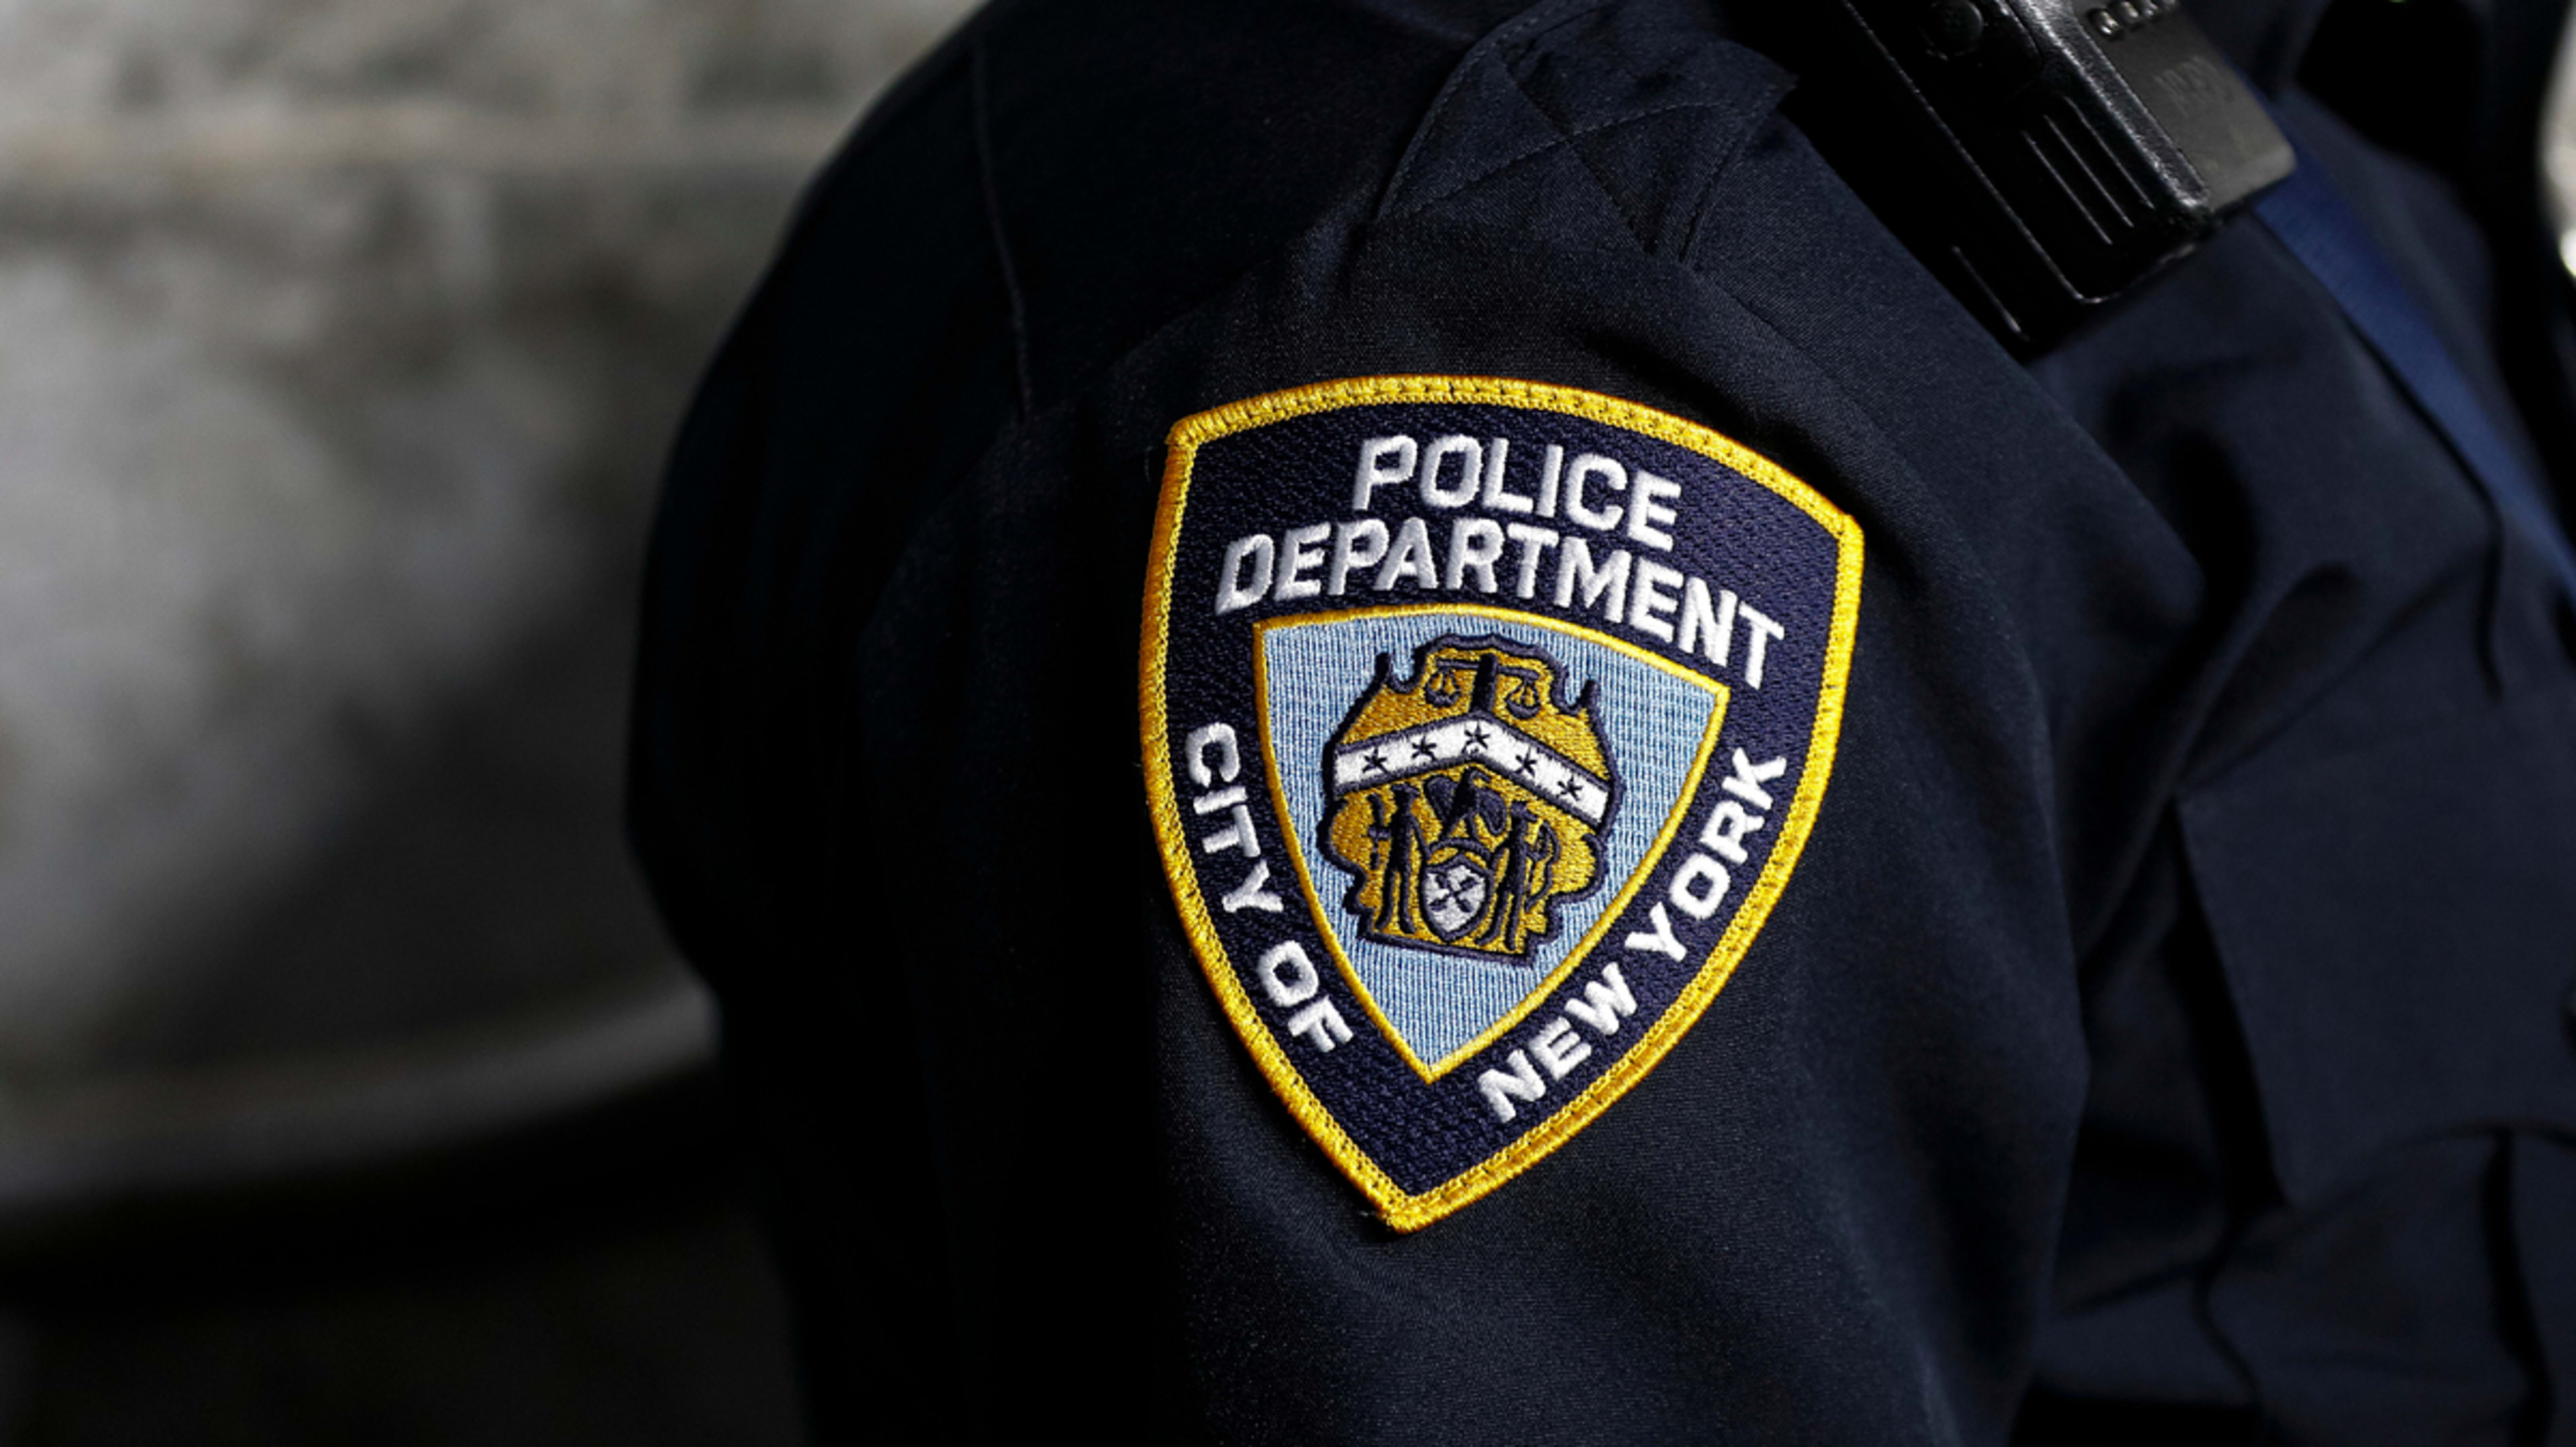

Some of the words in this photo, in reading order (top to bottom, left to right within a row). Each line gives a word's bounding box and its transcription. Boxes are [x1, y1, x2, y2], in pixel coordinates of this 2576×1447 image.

[1215, 517, 1785, 690] DEPARTMENT
[1352, 434, 1682, 552] POLICE
[1187, 722, 1284, 914] CITY
[1256, 941, 1354, 1051] OF
[1477, 962, 1638, 1121] NEW
[1624, 747, 1787, 962] YORK
